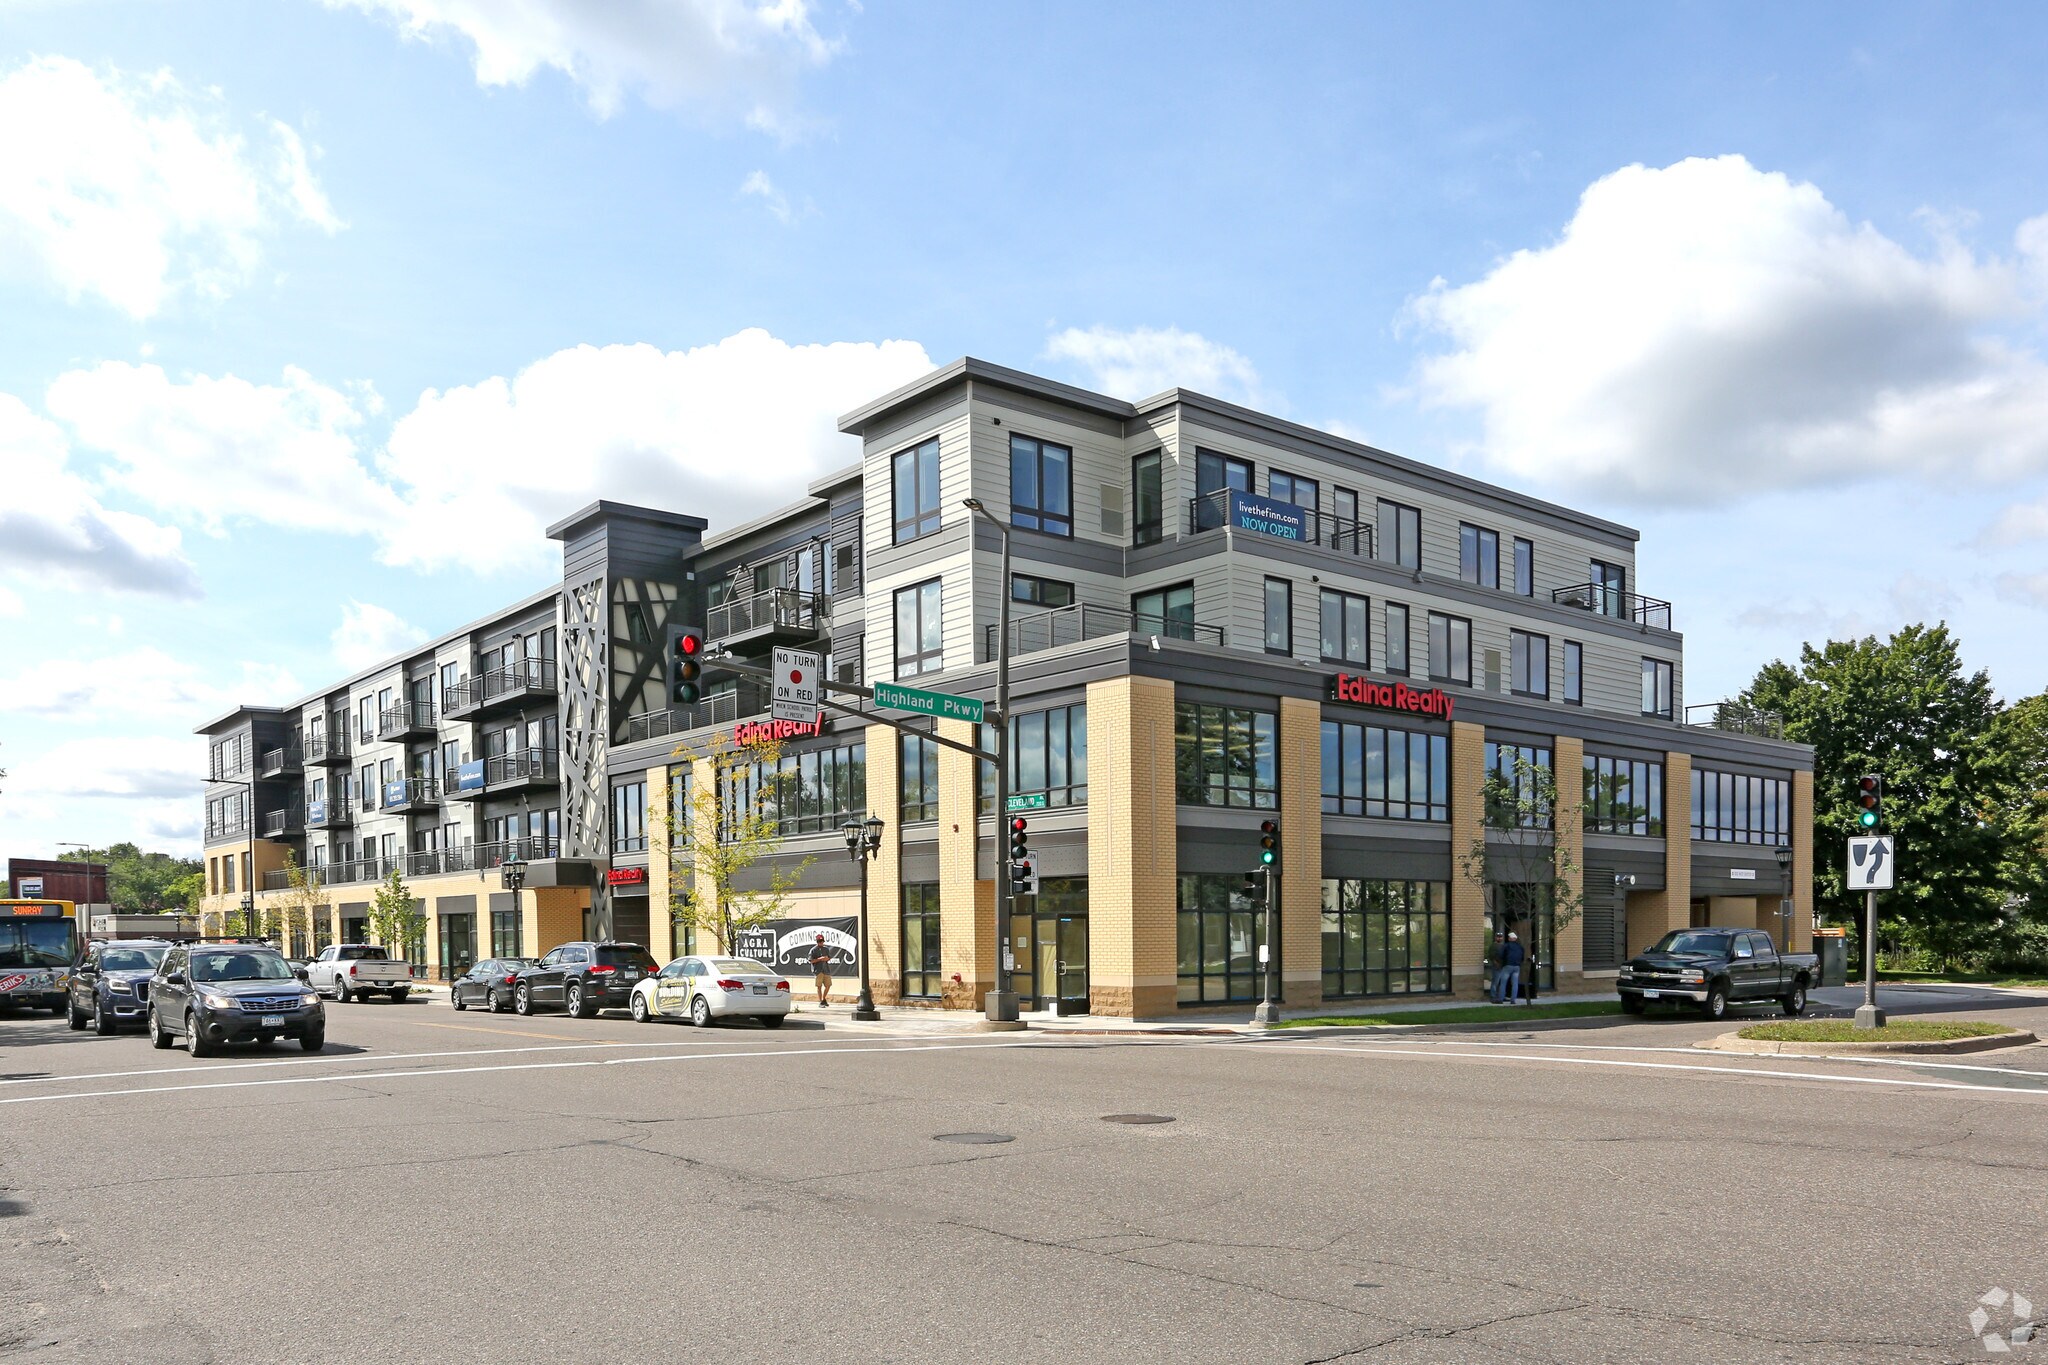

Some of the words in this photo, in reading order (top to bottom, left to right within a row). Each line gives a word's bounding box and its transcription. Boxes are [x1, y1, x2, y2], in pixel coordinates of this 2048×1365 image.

[1239, 500, 1299, 525] livethefinn.com
[1241, 516, 1268, 533] NOW
[1269, 523, 1297, 539] OPEN
[776, 652, 788, 664] NO
[793, 654, 816, 668] TURN
[777, 686, 790, 698] ON
[796, 689, 813, 701] RED
[1337, 672, 1392, 707] Edina
[1395, 682, 1455, 721] Realty
[786, 703, 800, 711] SCHOOL
[877, 688, 933, 710] Highland
[944, 699, 980, 720] Pkwy
[789, 711, 805, 719] PRESENT
[734, 721, 772, 747] Edina
[1007, 797, 1035, 808] CLEVELAND
[12, 906, 43, 915] SUNRAY
[743, 938, 768, 948] AGRA
[789, 930, 818, 946] COMING
[739, 948, 773, 958] CULTURE
